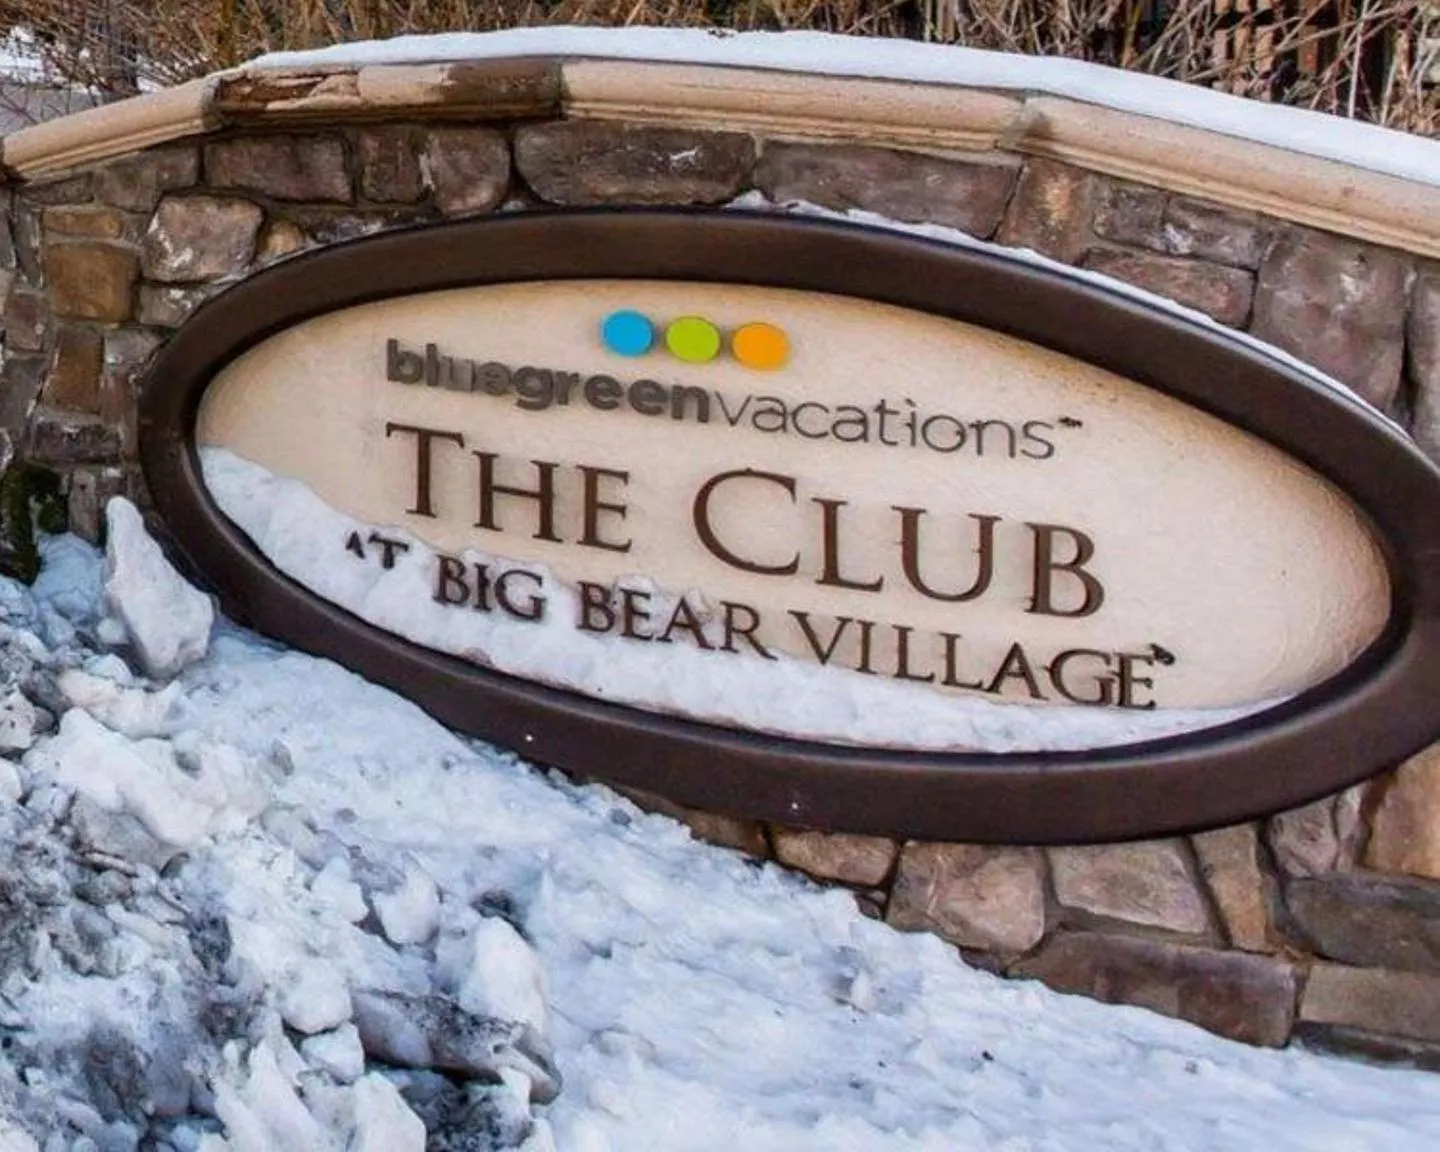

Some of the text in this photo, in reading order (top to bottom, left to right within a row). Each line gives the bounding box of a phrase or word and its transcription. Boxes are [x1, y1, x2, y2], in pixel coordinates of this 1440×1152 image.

[385, 421, 1106, 619] THE CLUB
[432, 553, 549, 622] BIG
[575, 580, 779, 662] BEAR
[787, 609, 1157, 711] VILLAGE
